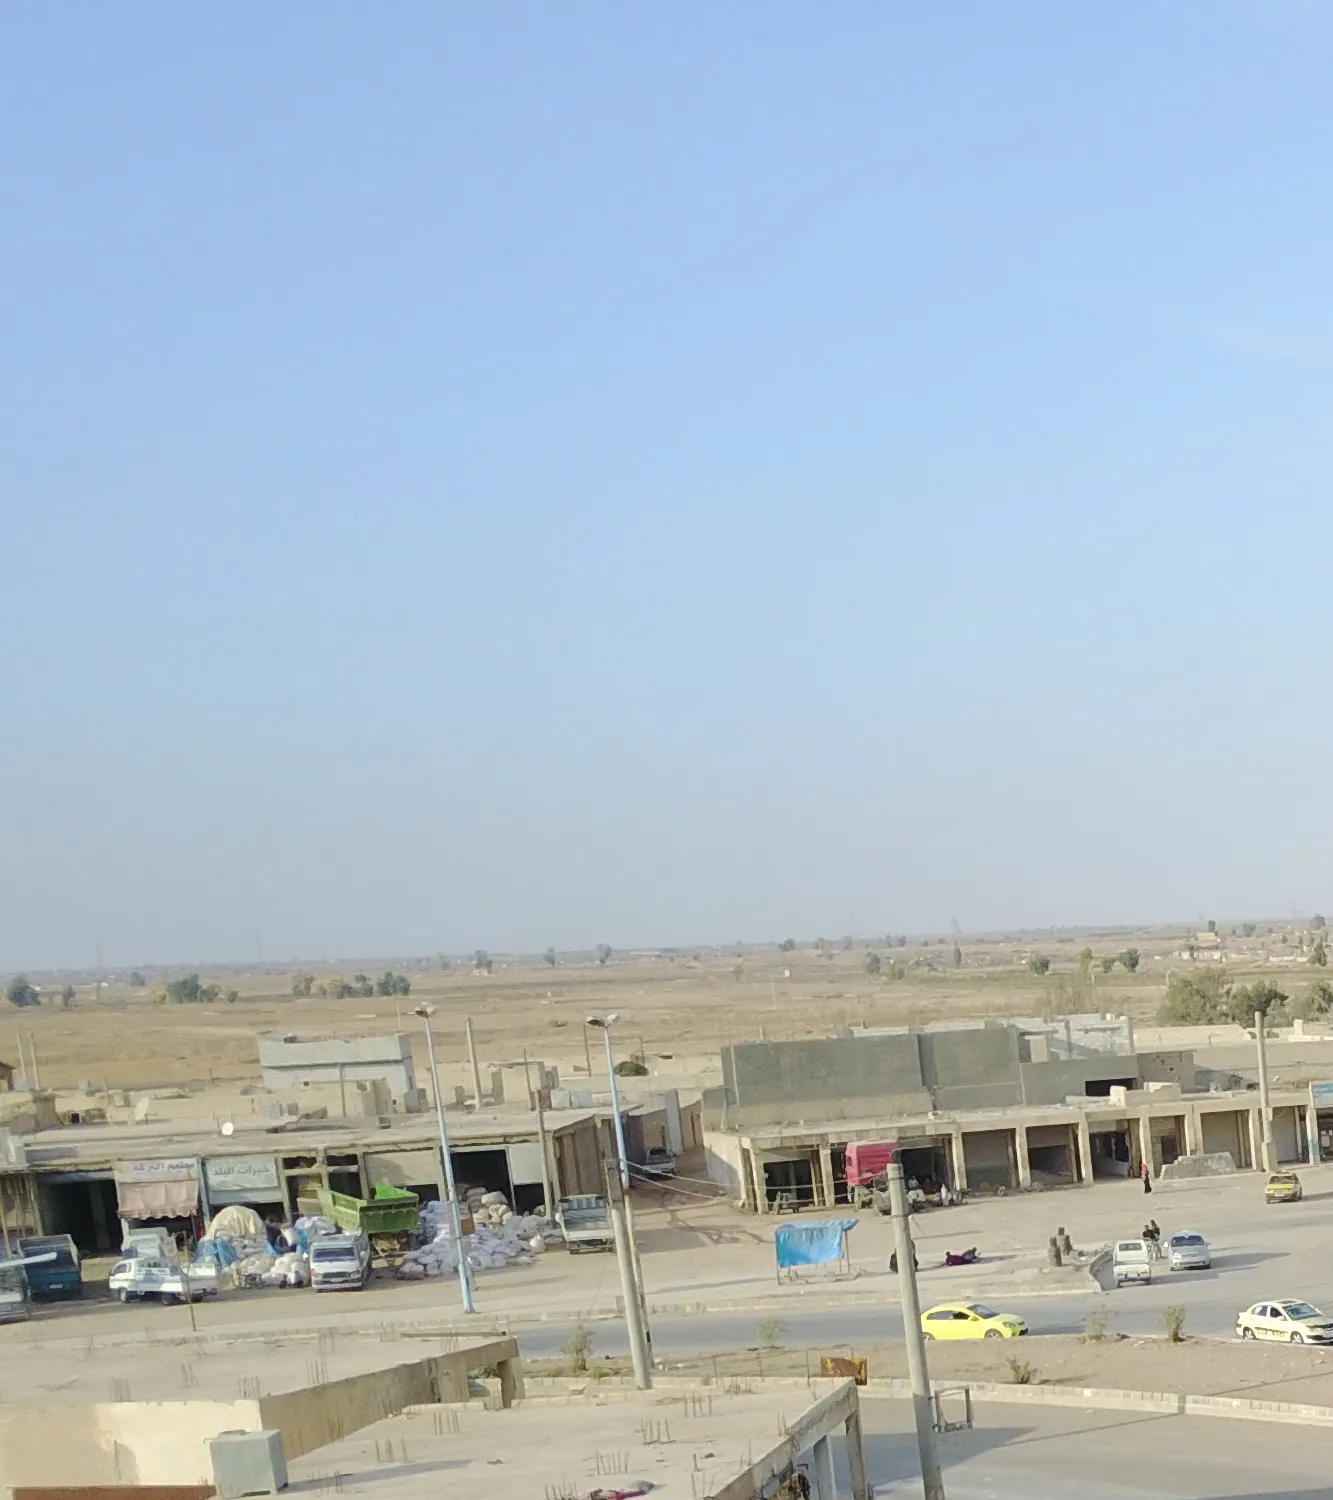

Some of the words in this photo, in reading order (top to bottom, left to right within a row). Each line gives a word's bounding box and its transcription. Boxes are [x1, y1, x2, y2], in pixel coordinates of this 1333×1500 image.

[167, 1162, 195, 1171] مطعم
[212, 1166, 234, 1176] البلد
[237, 1165, 270, 1176] خيرات
